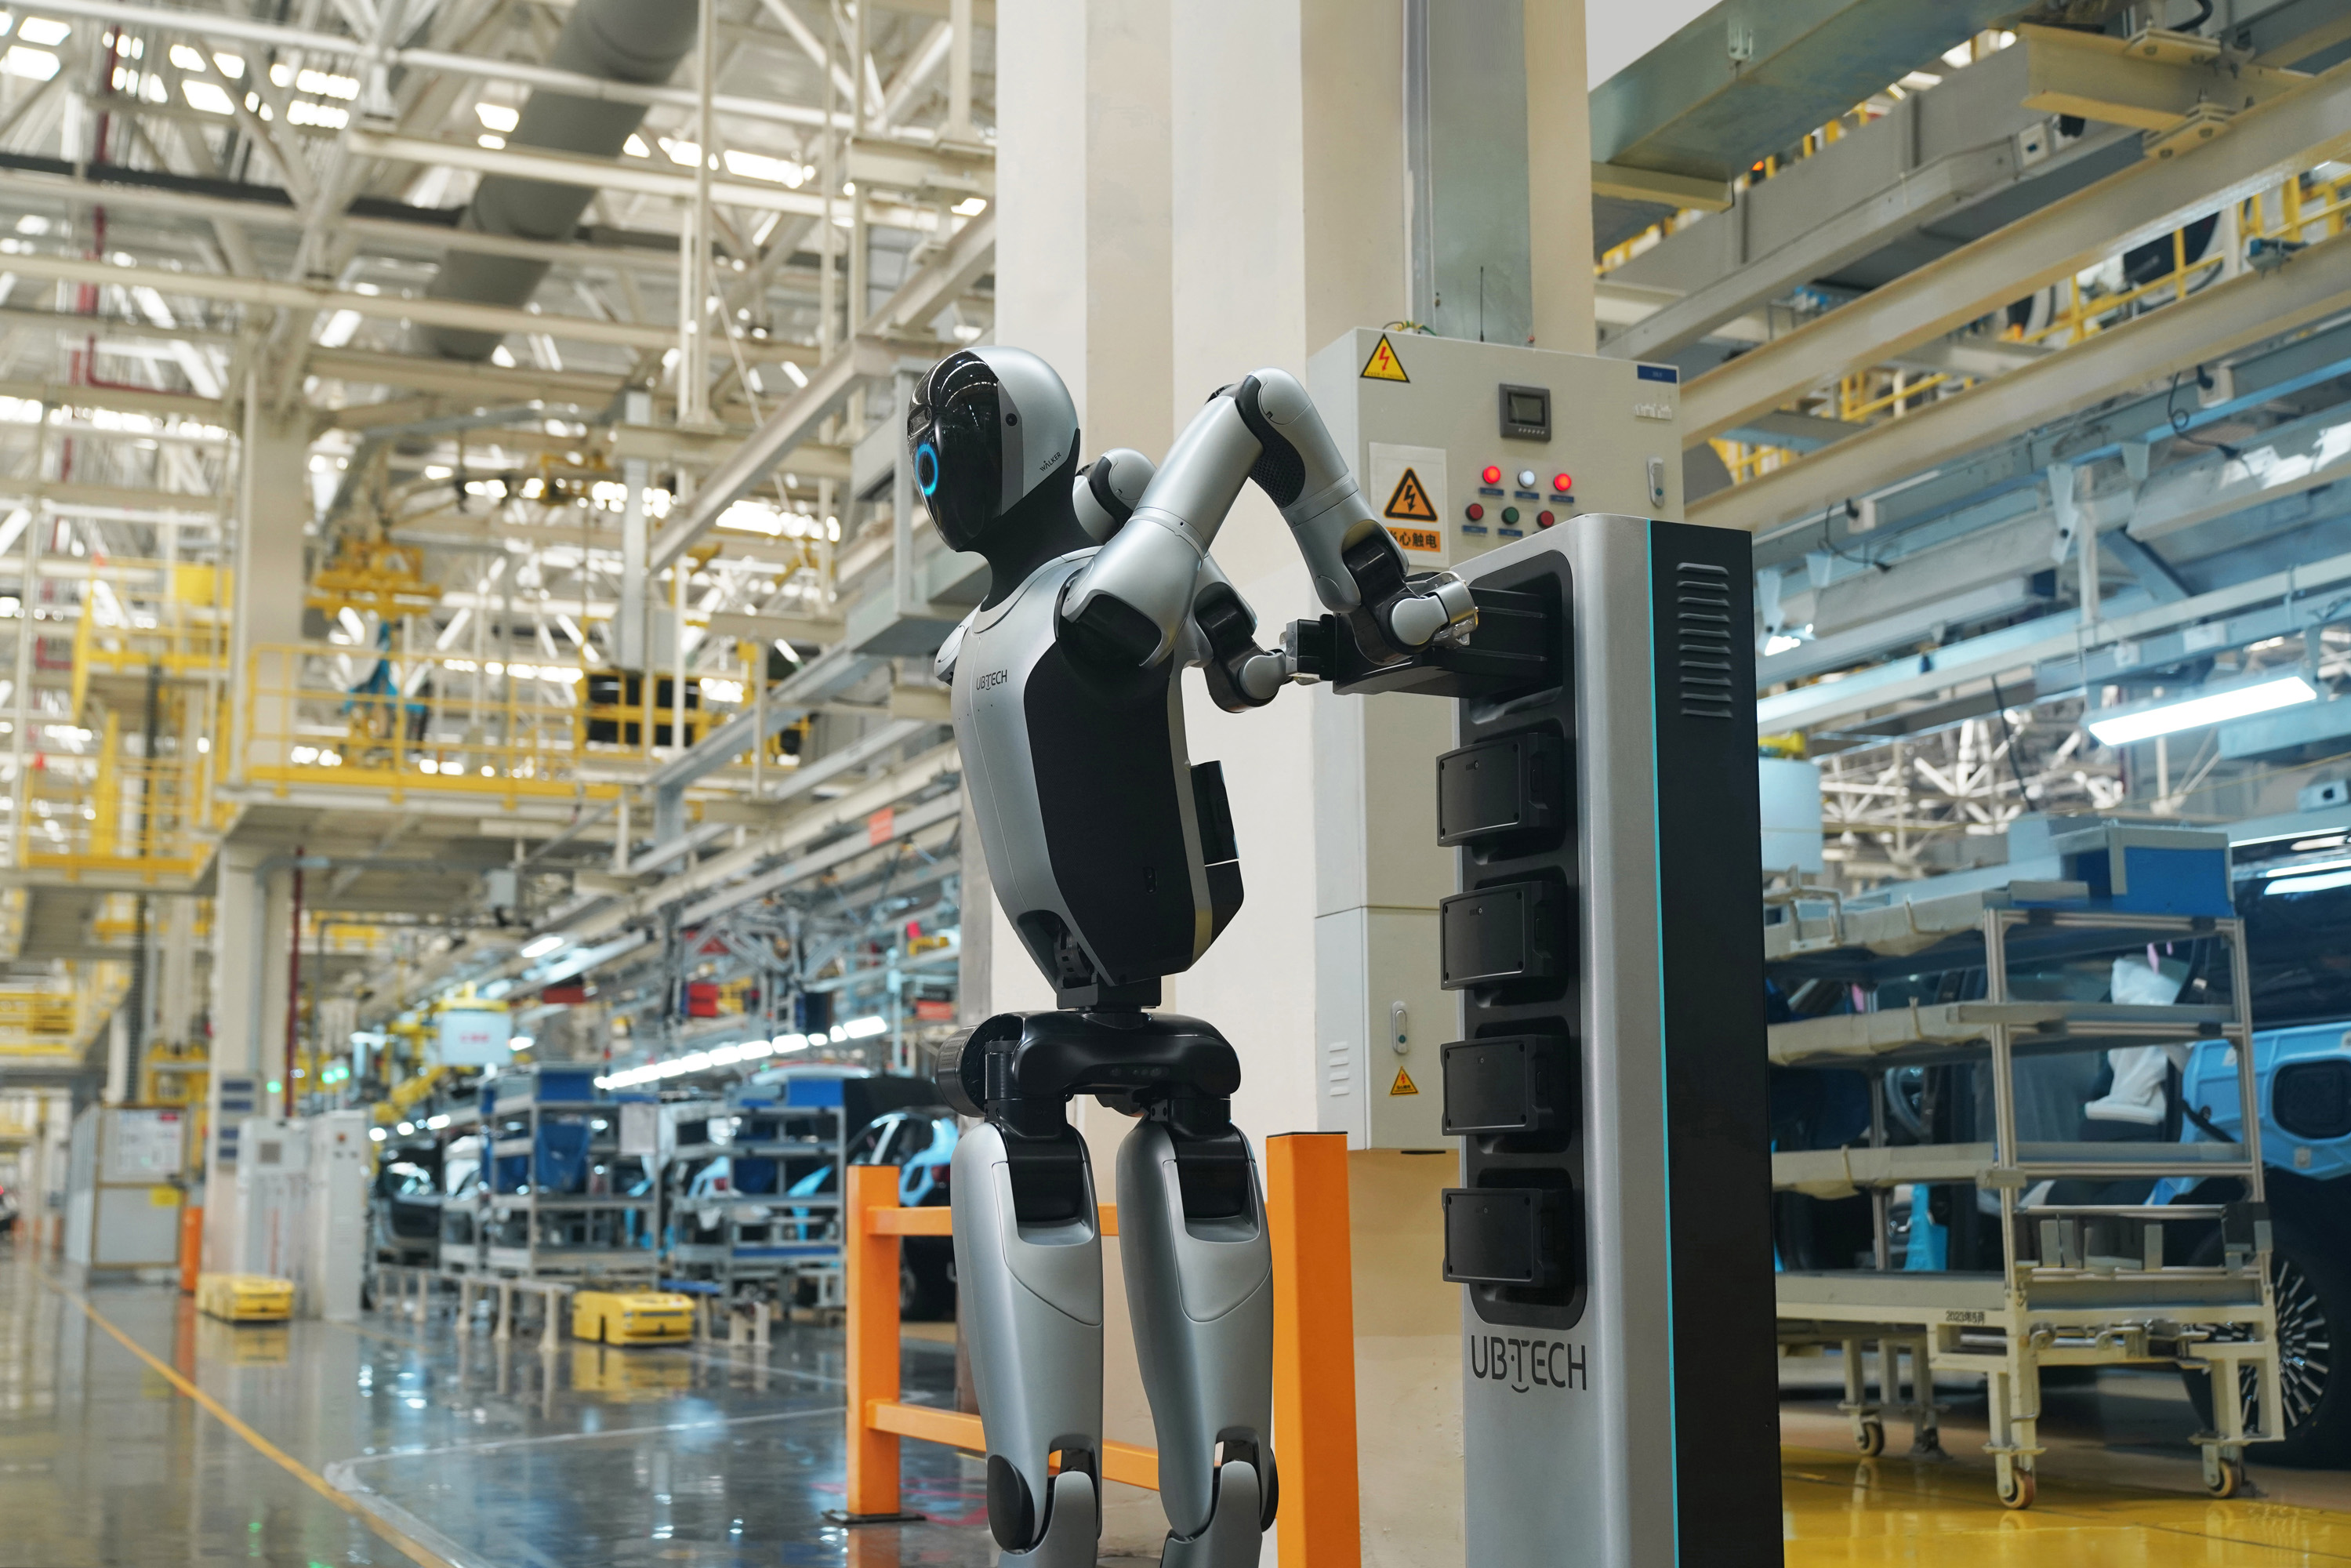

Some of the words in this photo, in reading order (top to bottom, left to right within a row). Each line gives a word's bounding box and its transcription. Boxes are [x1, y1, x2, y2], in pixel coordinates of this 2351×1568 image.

[1039, 452, 1061, 472] WALKER
[976, 669, 1007, 691] UBTECH
[1471, 1334, 1587, 1393] UBTECH
